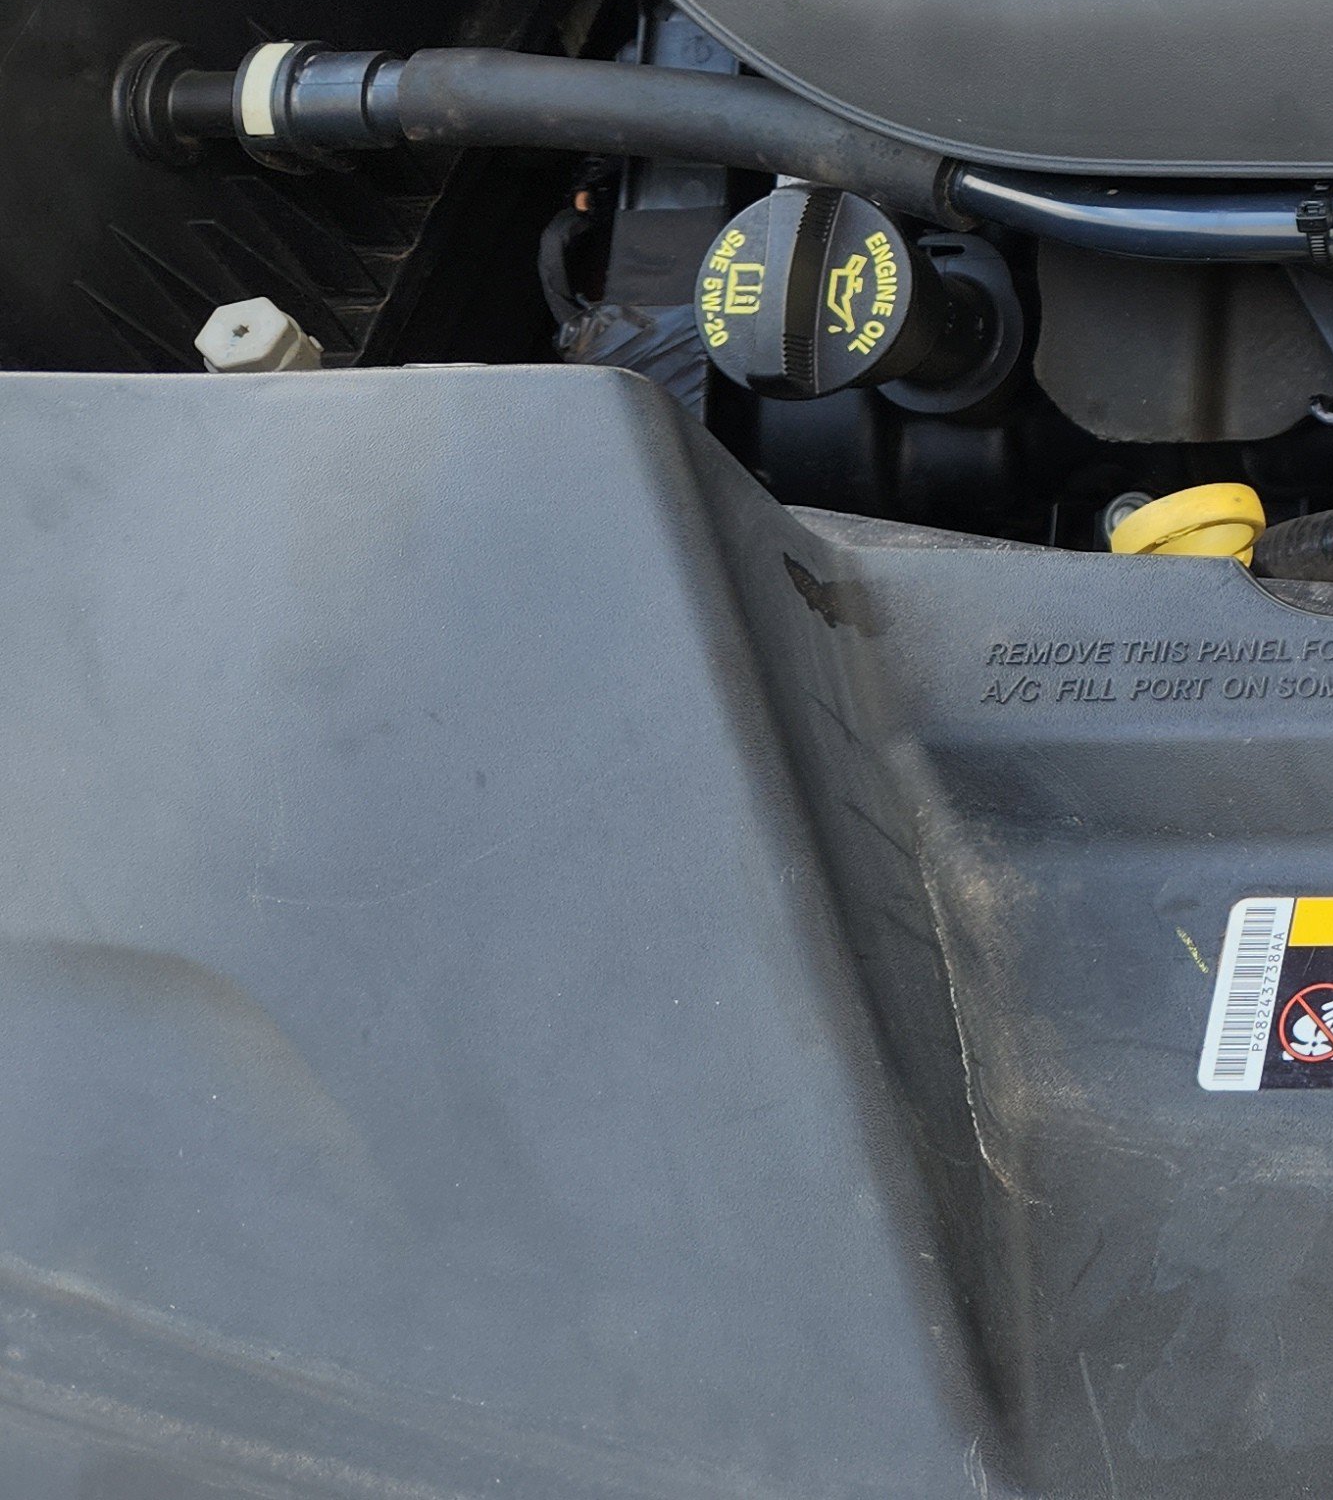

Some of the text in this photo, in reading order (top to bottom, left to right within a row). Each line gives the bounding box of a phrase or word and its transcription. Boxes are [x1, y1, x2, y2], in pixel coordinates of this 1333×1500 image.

[702, 278, 730, 349] 5W-20
[847, 231, 898, 357] ENGINE OIL
[985, 641, 1118, 667] REMOVE
[1120, 639, 1190, 665] THIS
[1196, 638, 1295, 663] PANEL
[981, 673, 1040, 704] A/C
[1055, 677, 1117, 702] FILL
[1129, 676, 1212, 700] PORT
[1222, 675, 1271, 699] ON
[1250, 930, 1287, 1053] P68243738AA
